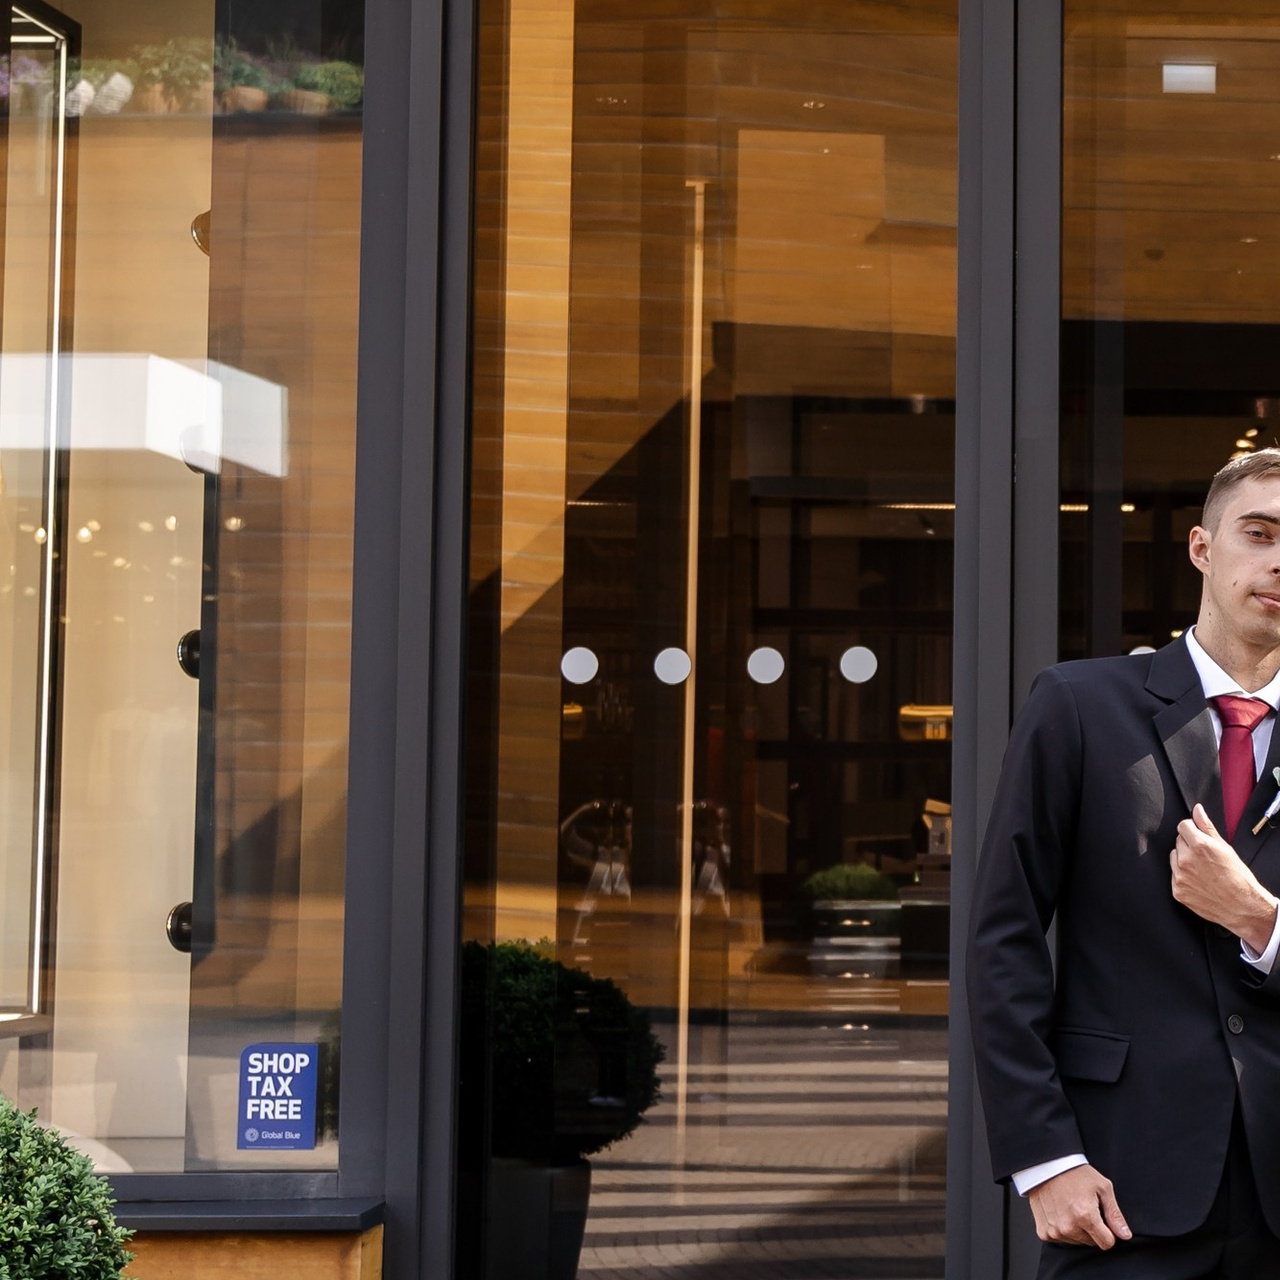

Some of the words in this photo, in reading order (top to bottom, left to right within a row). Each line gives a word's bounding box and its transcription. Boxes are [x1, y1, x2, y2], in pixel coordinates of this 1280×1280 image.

[248, 1053, 310, 1074] SHOP
[247, 1076, 293, 1097] TAX
[246, 1099, 302, 1120] FREE
[261, 1131, 283, 1139] Global
[284, 1131, 301, 1140] Blue
